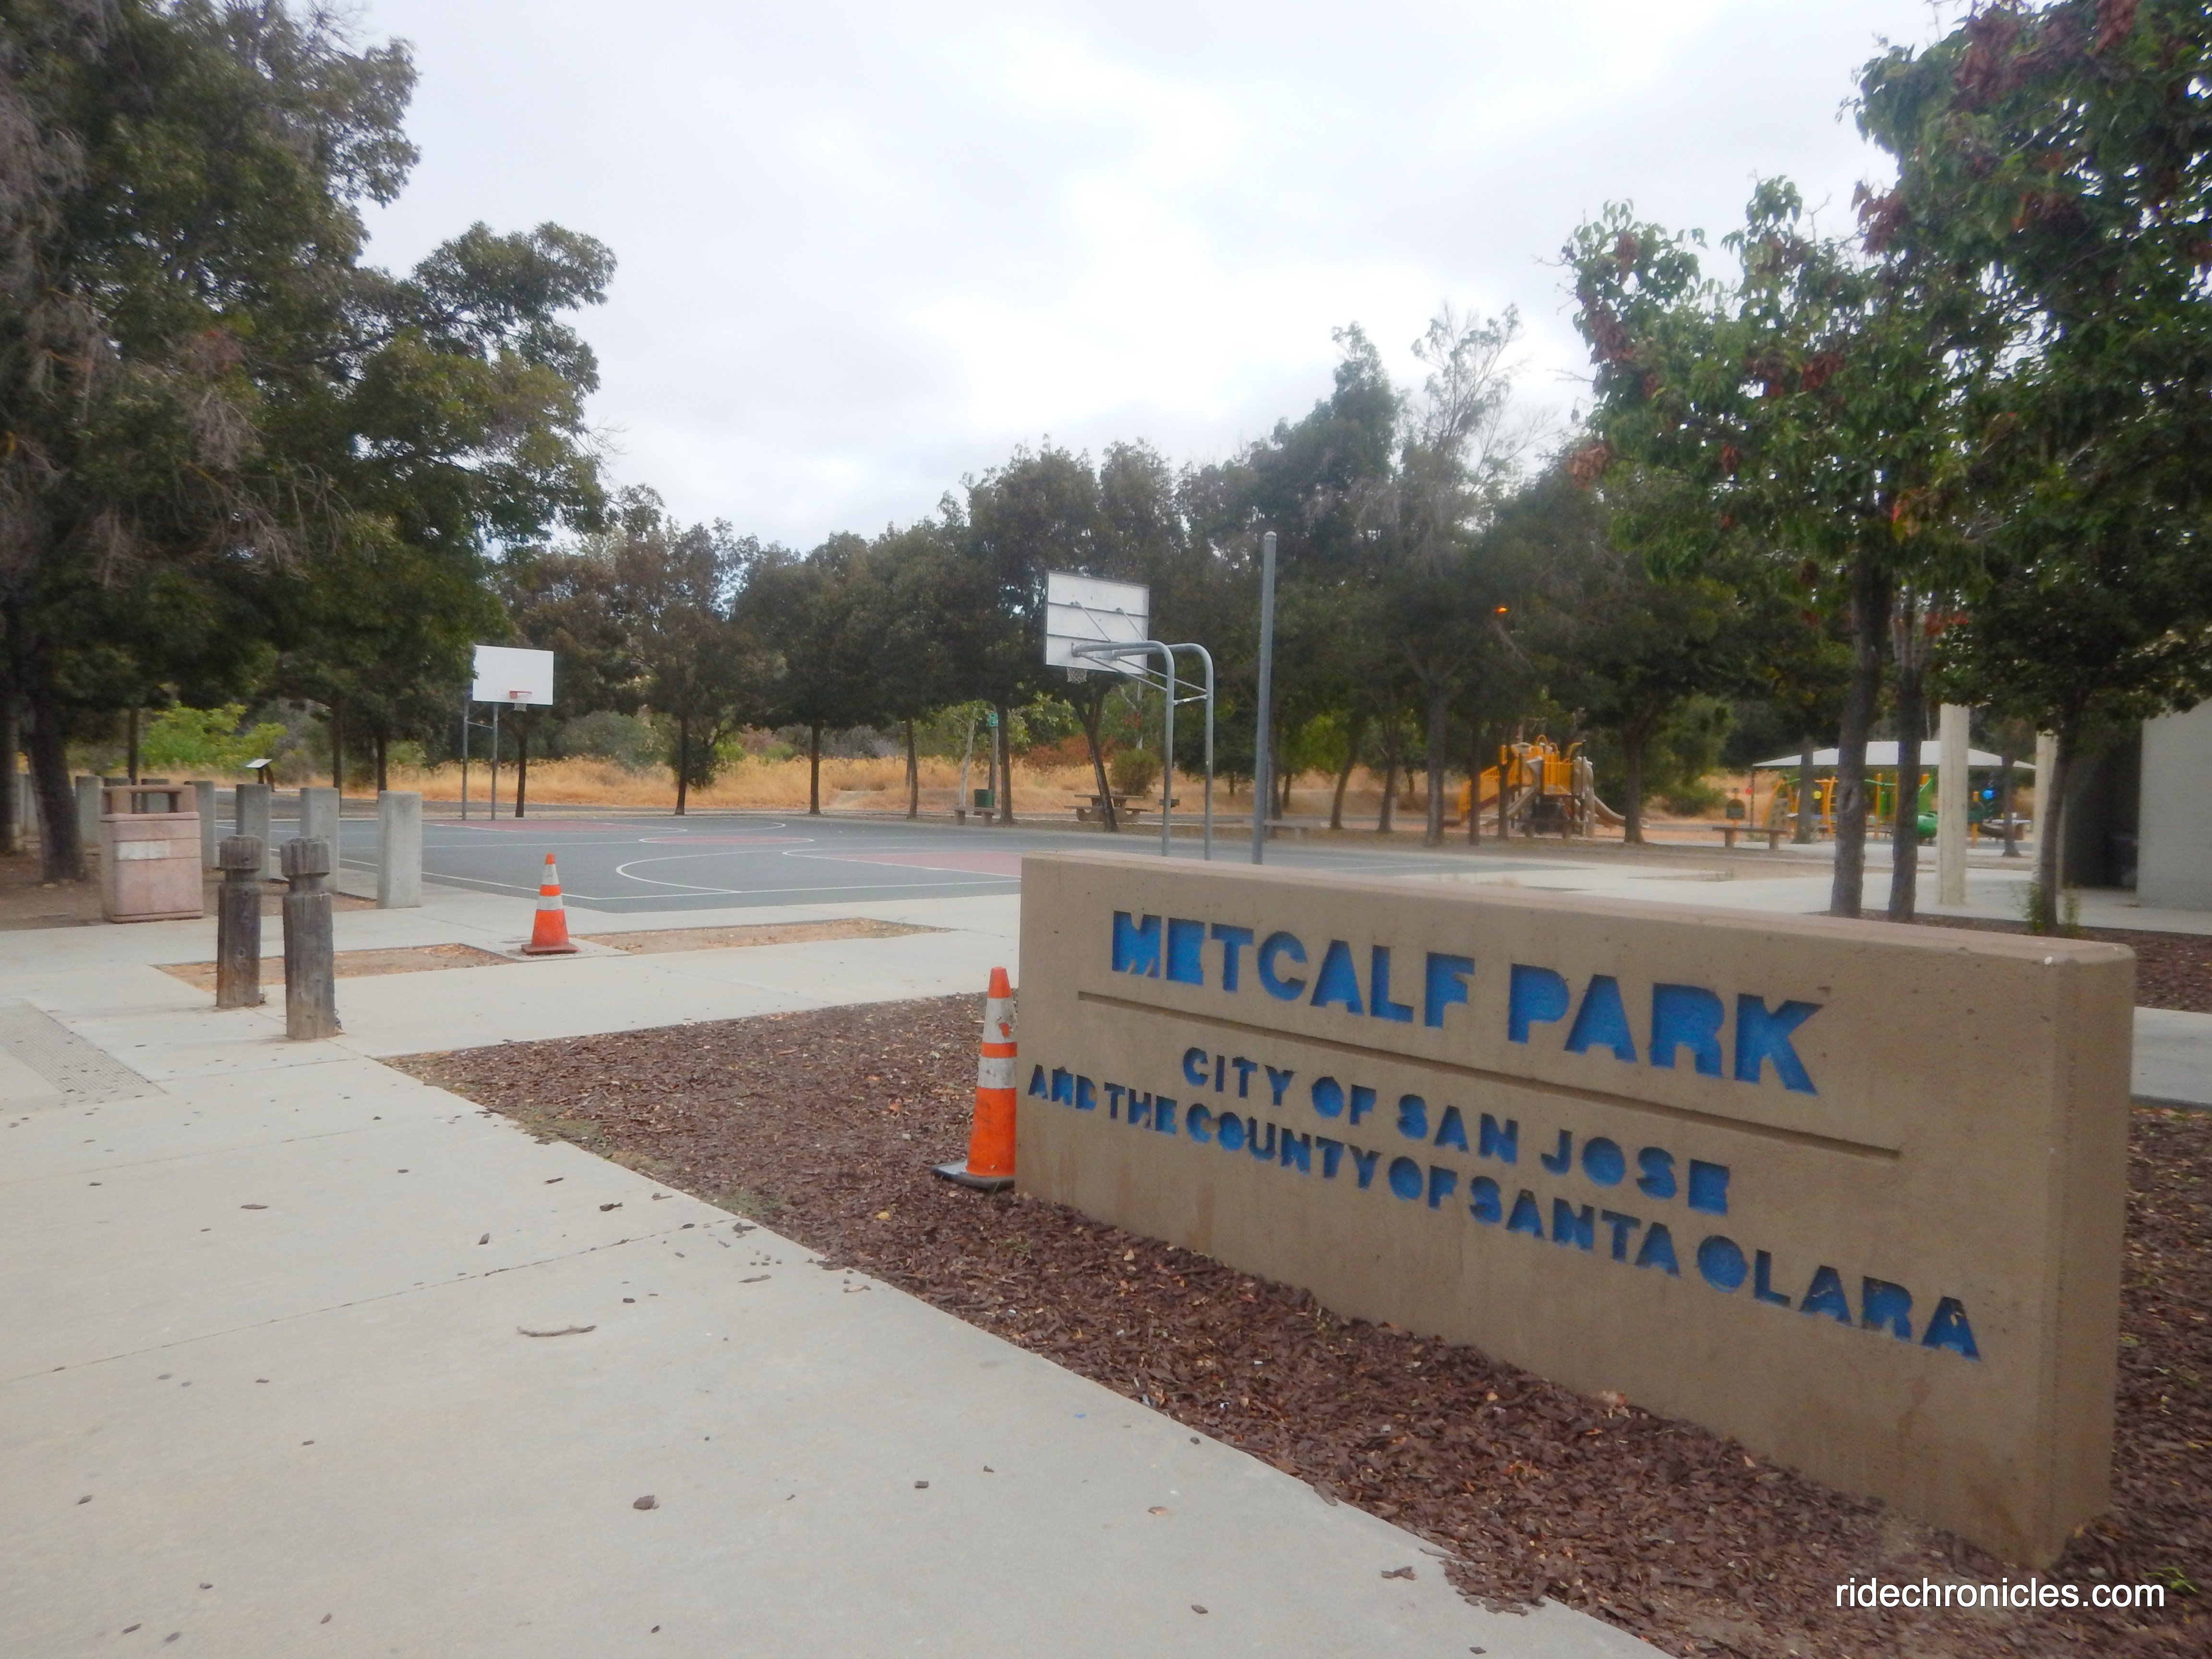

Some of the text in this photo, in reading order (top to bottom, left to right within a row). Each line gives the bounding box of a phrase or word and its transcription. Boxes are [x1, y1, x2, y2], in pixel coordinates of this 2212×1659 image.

[1111, 911, 1823, 1097] METCALF PARK
[1028, 1064, 1098, 1112] AND
[1104, 1082, 1178, 1137] THE
[1186, 1103, 1382, 1190] COUNTY
[1387, 1155, 1458, 1211] OF
[1469, 1175, 1681, 1279] SANTA
[1182, 1046, 1731, 1217] CITY OF SAN JOSE
